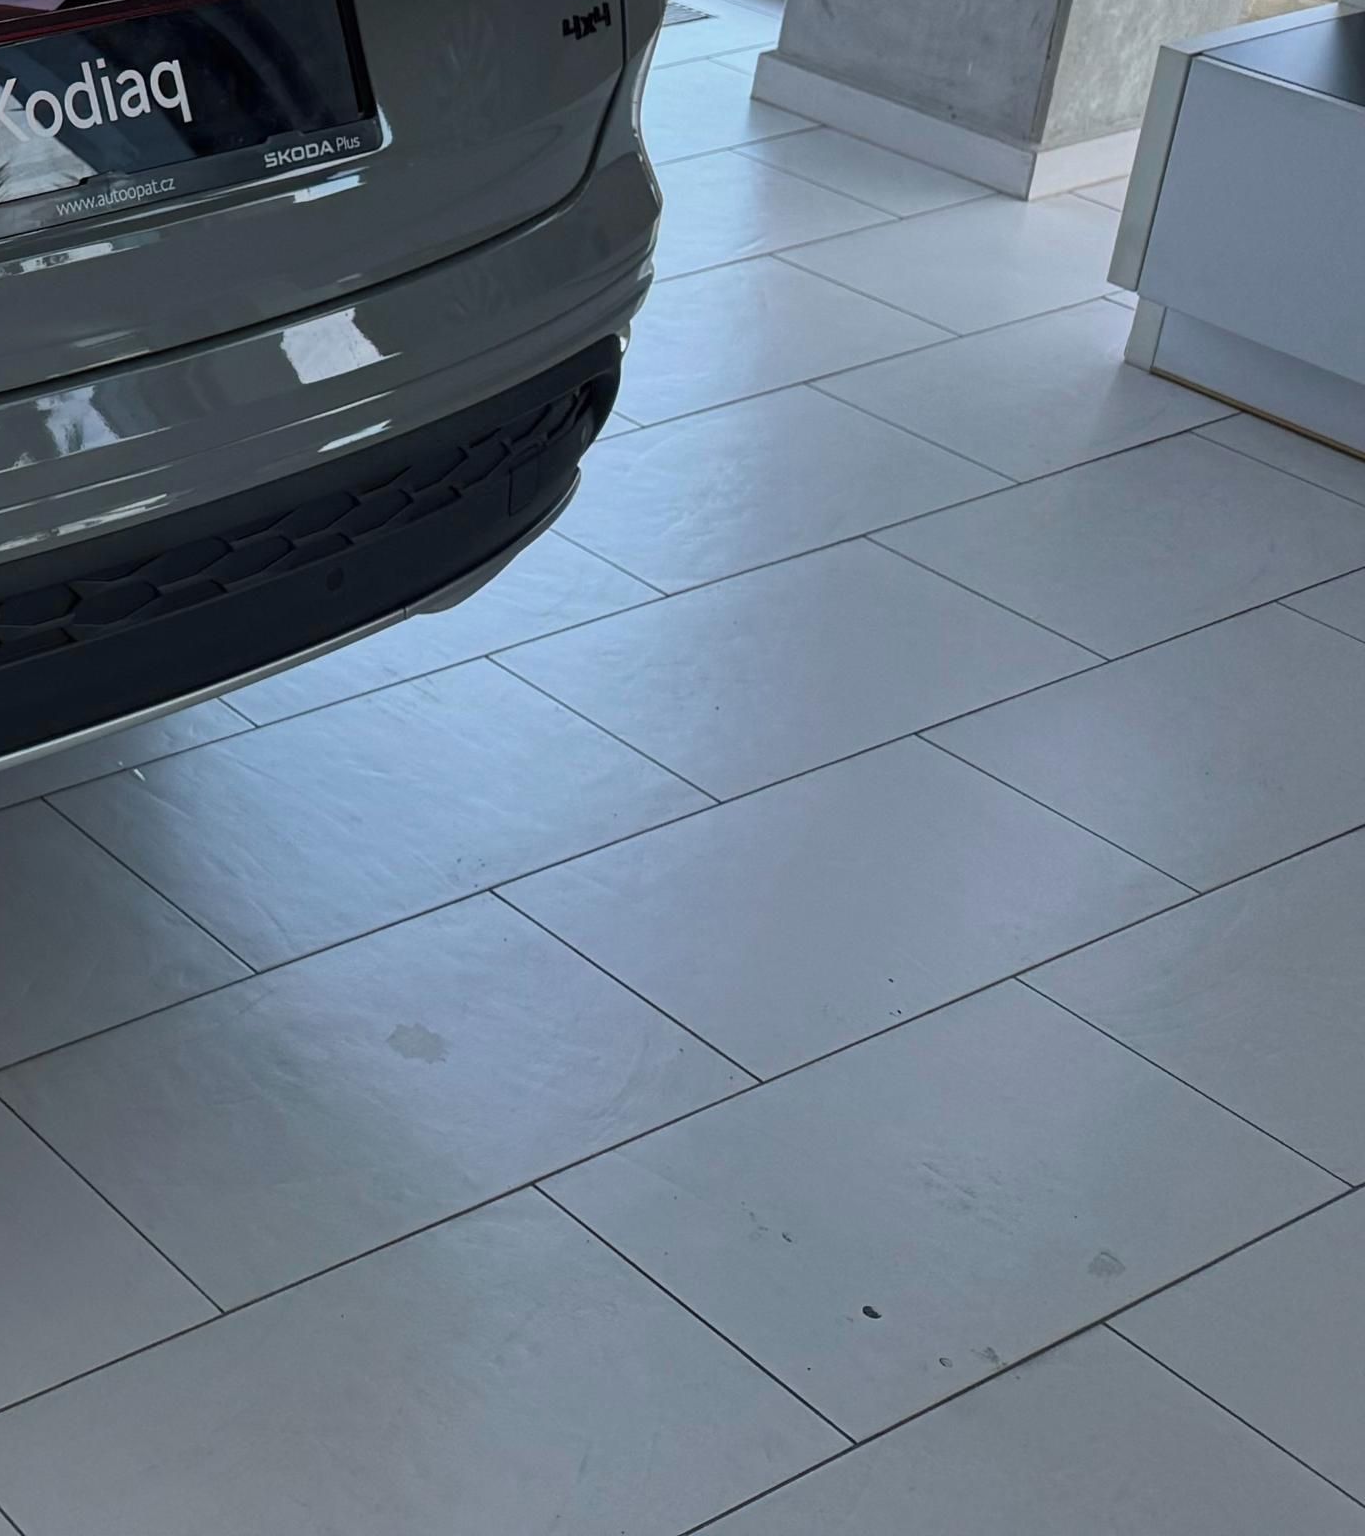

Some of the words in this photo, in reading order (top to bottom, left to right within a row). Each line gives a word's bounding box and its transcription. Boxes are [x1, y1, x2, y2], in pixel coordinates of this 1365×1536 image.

[263, 140, 335, 169] SKODA
[335, 135, 361, 152] Plus
[55, 176, 177, 217] www.autoopat.cz
